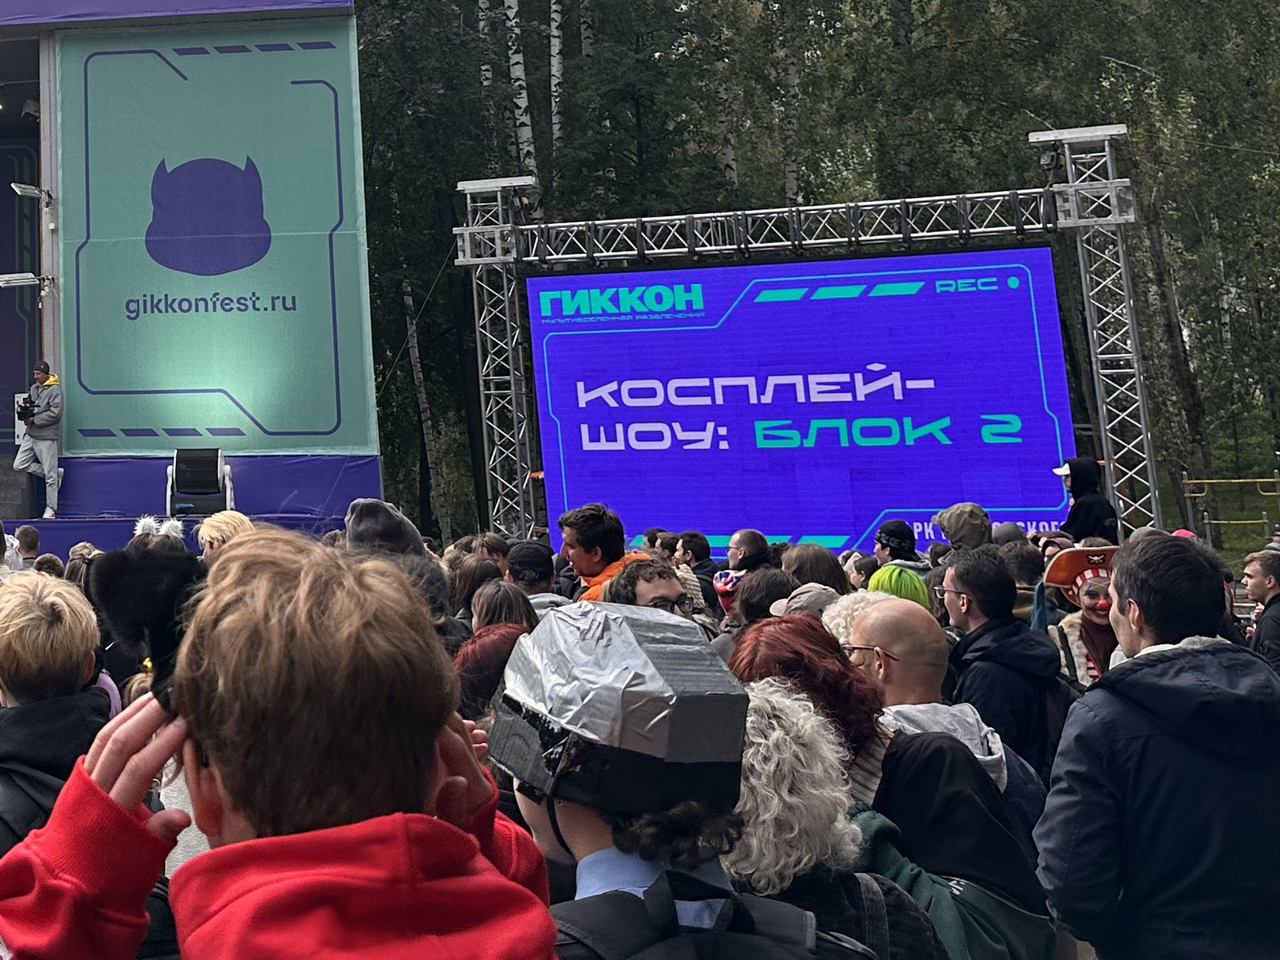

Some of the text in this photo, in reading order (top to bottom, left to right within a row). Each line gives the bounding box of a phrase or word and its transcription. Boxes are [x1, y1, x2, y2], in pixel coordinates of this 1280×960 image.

[539, 283, 704, 317] ГИККОН
[936, 277, 999, 293] REC
[125, 291, 297, 321] gikkonfest.ru
[576, 362, 935, 408] КОСПЛЕЙ-
[581, 414, 1022, 451] ШОУ: БЛОК 2
